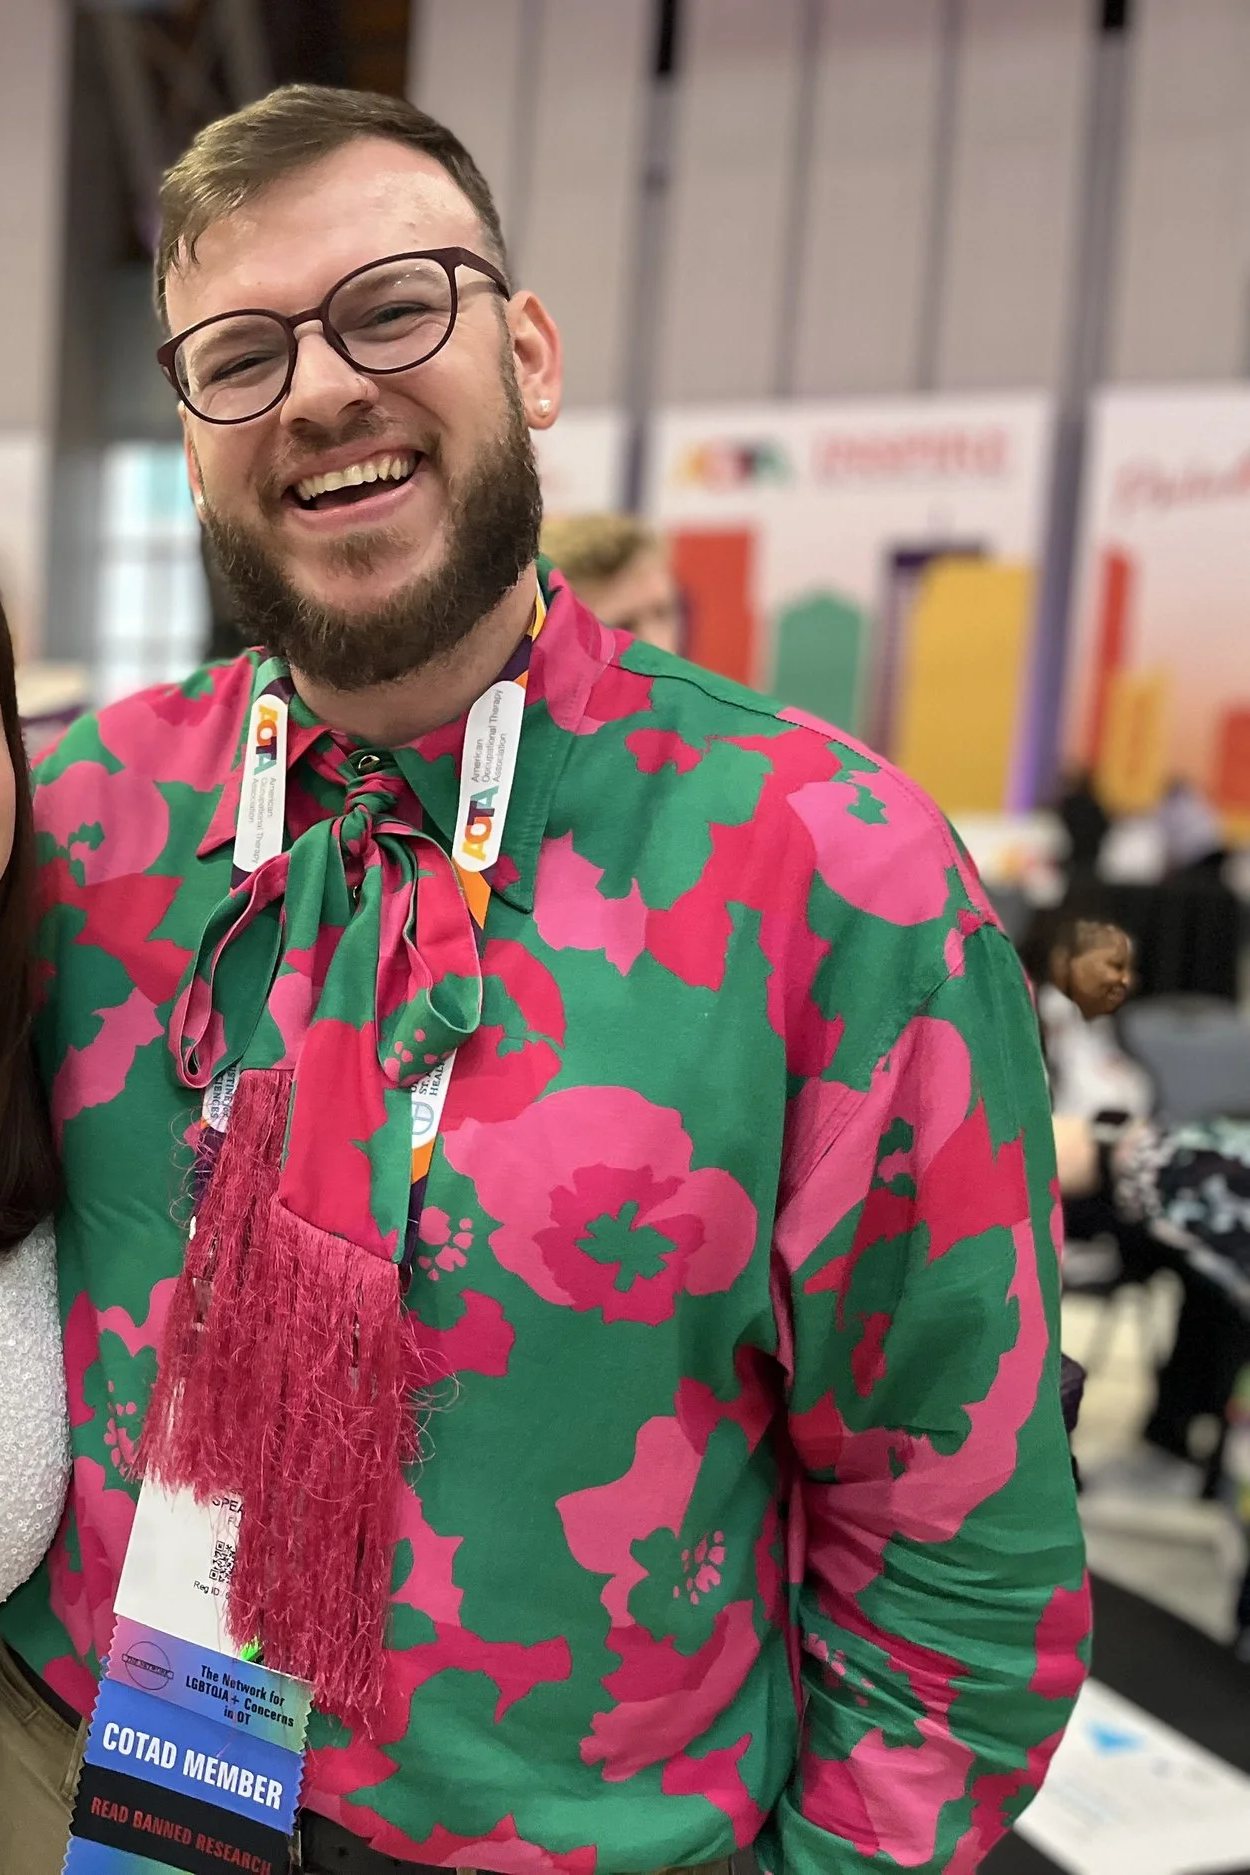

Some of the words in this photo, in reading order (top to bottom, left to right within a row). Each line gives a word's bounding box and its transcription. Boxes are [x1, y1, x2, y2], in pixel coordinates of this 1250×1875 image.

[489, 689, 503, 724] Therapy
[253, 704, 278, 776] AOTA
[471, 738, 483, 782] American
[482, 725, 497, 783] Occupational
[493, 733, 507, 782] Association
[267, 777, 276, 817] American
[461, 785, 499, 861] AOTA
[252, 832, 264, 864] Therapy
[193, 1580, 209, 1594] Reg
[211, 1587, 220, 1596] ID
[201, 1665, 219, 1682] The
[222, 1673, 267, 1700] Network
[269, 1691, 285, 1707] for
[224, 1705, 234, 1718] in
[237, 1711, 251, 1725] OT
[244, 1698, 295, 1727] Concerns
[103, 1722, 177, 1769] COTAD
[183, 1749, 283, 1810] MEMBER
[91, 1796, 129, 1824] READ
[133, 1810, 192, 1845] BANNED
[196, 1833, 272, 1875] RESEARCH
